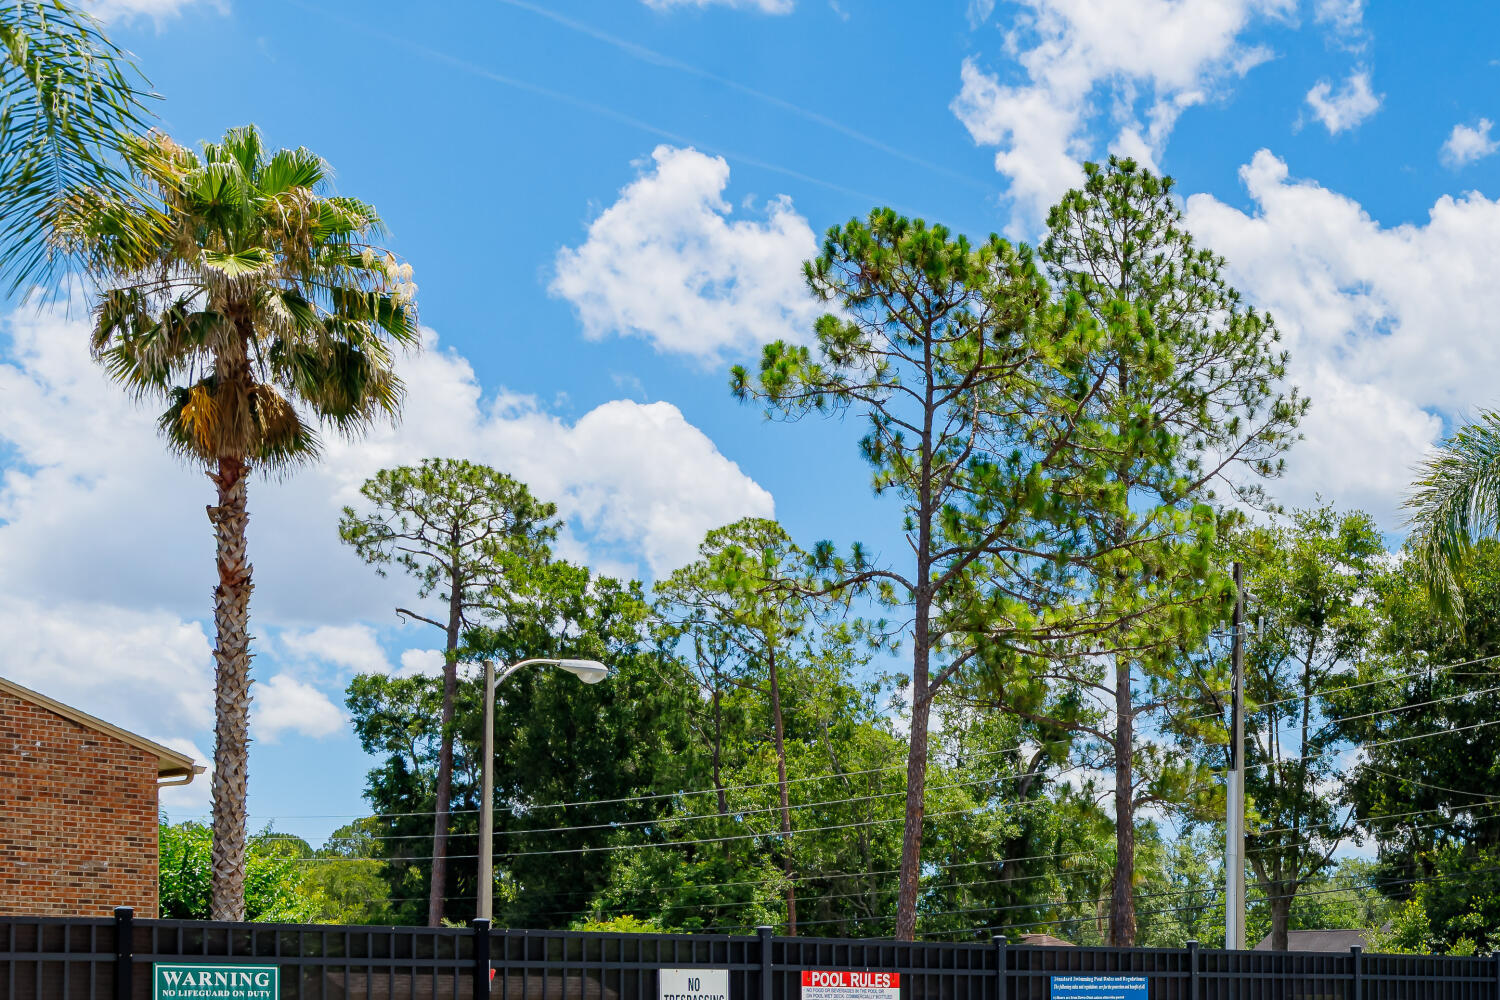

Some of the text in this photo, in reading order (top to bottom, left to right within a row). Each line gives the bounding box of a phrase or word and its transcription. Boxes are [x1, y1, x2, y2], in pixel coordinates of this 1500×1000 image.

[163, 971, 270, 986] WARNING
[688, 978, 700, 991] NO
[812, 972, 890, 987] POOL RULES
